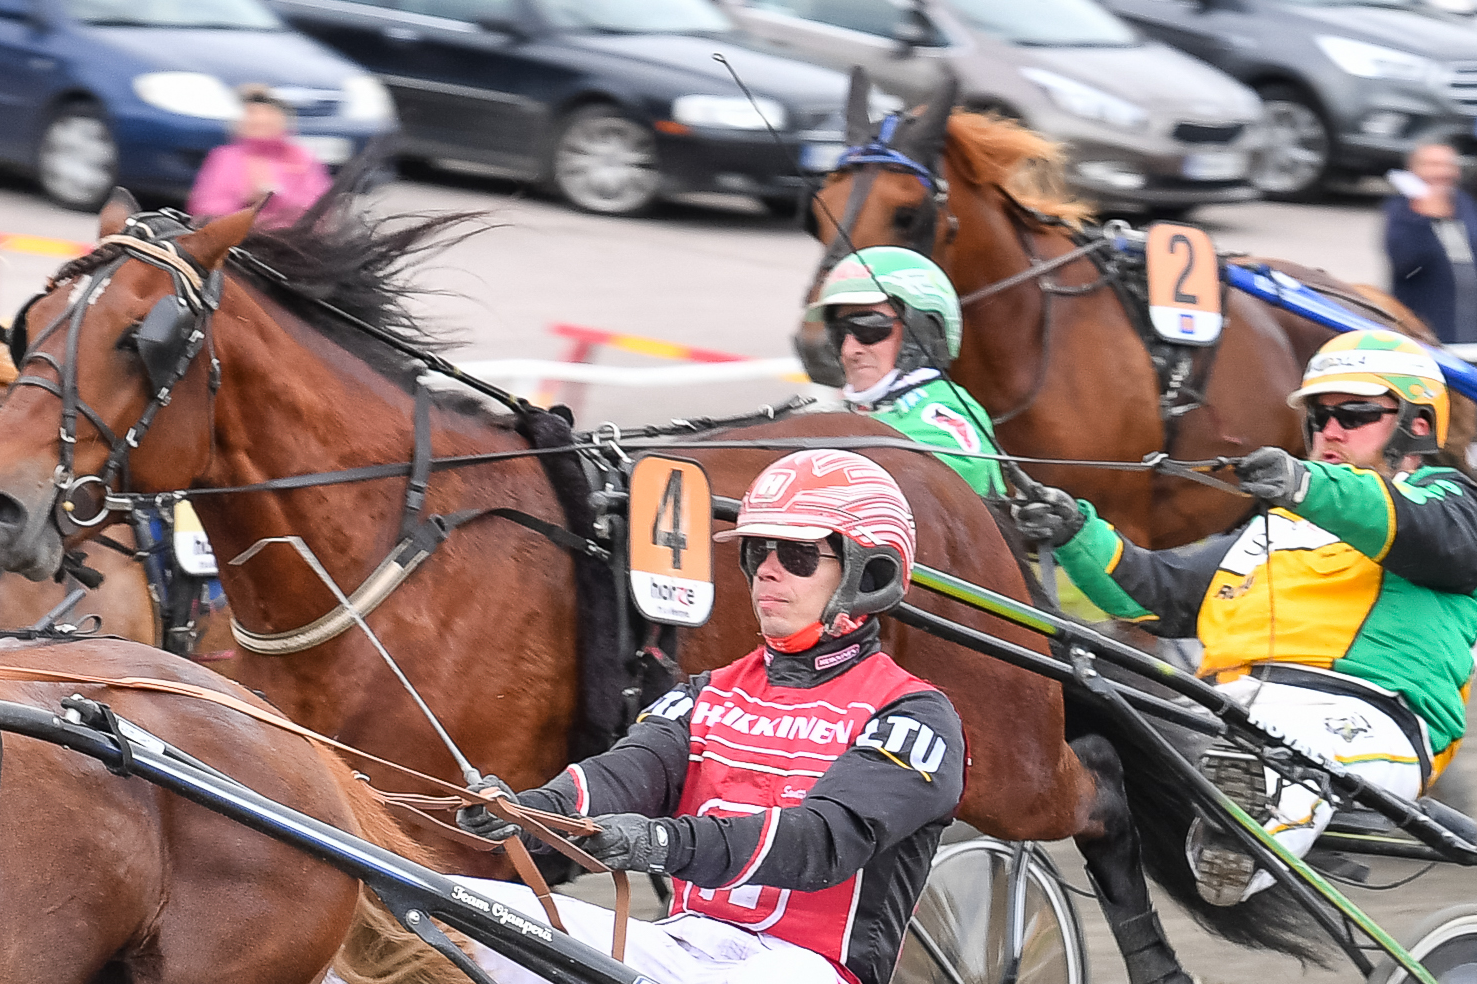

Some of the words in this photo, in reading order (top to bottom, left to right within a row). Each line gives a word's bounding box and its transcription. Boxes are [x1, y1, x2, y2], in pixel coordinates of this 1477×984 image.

[1169, 234, 1197, 304] 2
[651, 468, 688, 569] 4
[451, 885, 490, 912] Team
